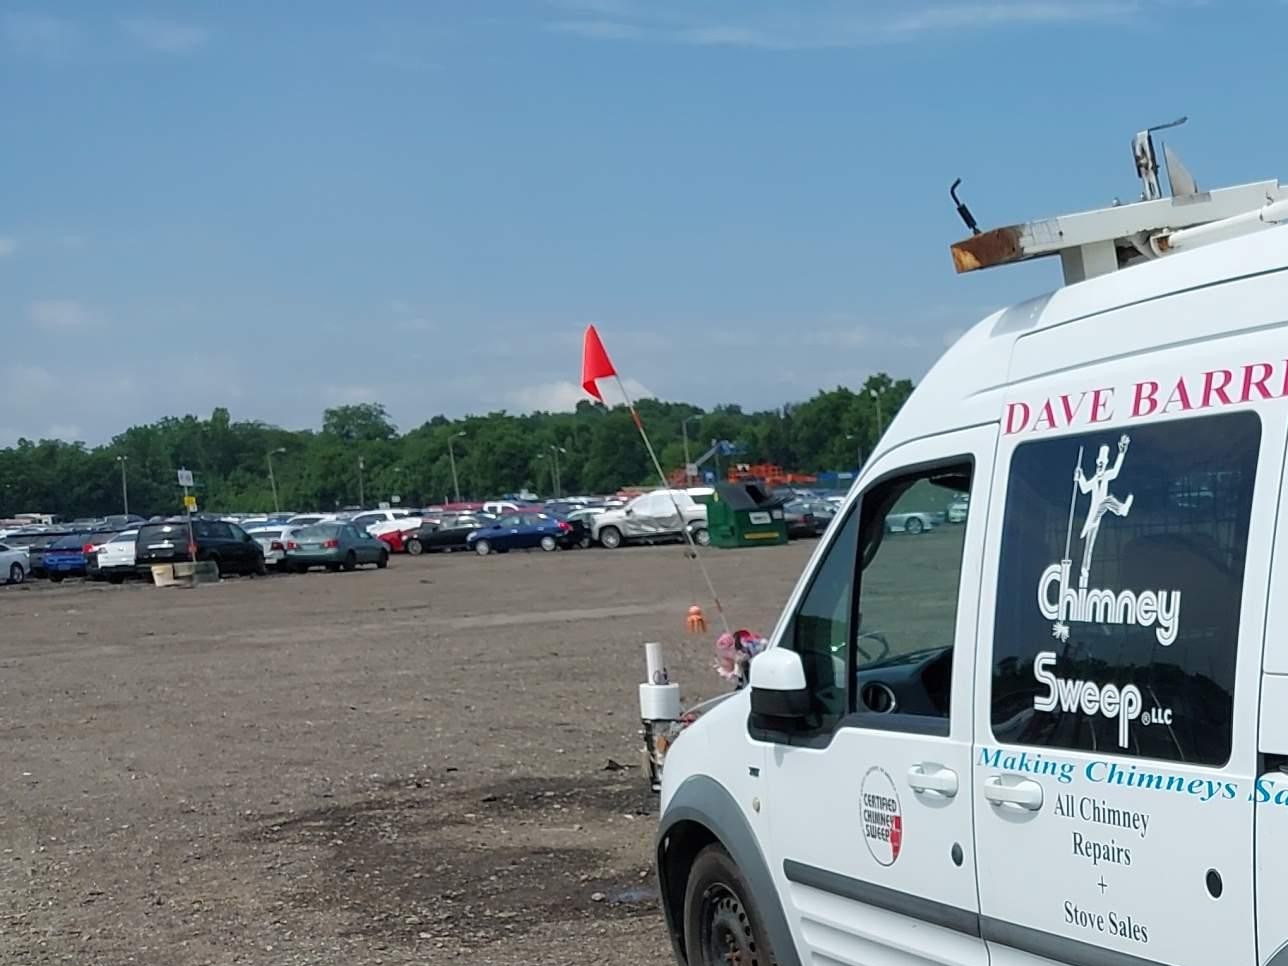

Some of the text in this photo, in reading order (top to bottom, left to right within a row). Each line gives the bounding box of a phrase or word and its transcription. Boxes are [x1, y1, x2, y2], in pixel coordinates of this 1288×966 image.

[1004, 387, 1114, 437] DAVE
[1038, 560, 1181, 646] Chimney
[1034, 652, 1173, 748] Sweep LLC
[977, 747, 1077, 784] Making
[1085, 761, 1239, 802] Chimneys
[863, 793, 897, 812] CERTIFIED
[863, 809, 894, 829] CHIMNEY
[1054, 793, 1150, 838] All Chimney
[865, 824, 890, 842] SWEEP
[1072, 831, 1132, 866] Repairs
[1097, 875, 1108, 895] +
[1064, 901, 1148, 943] Stove Sales
